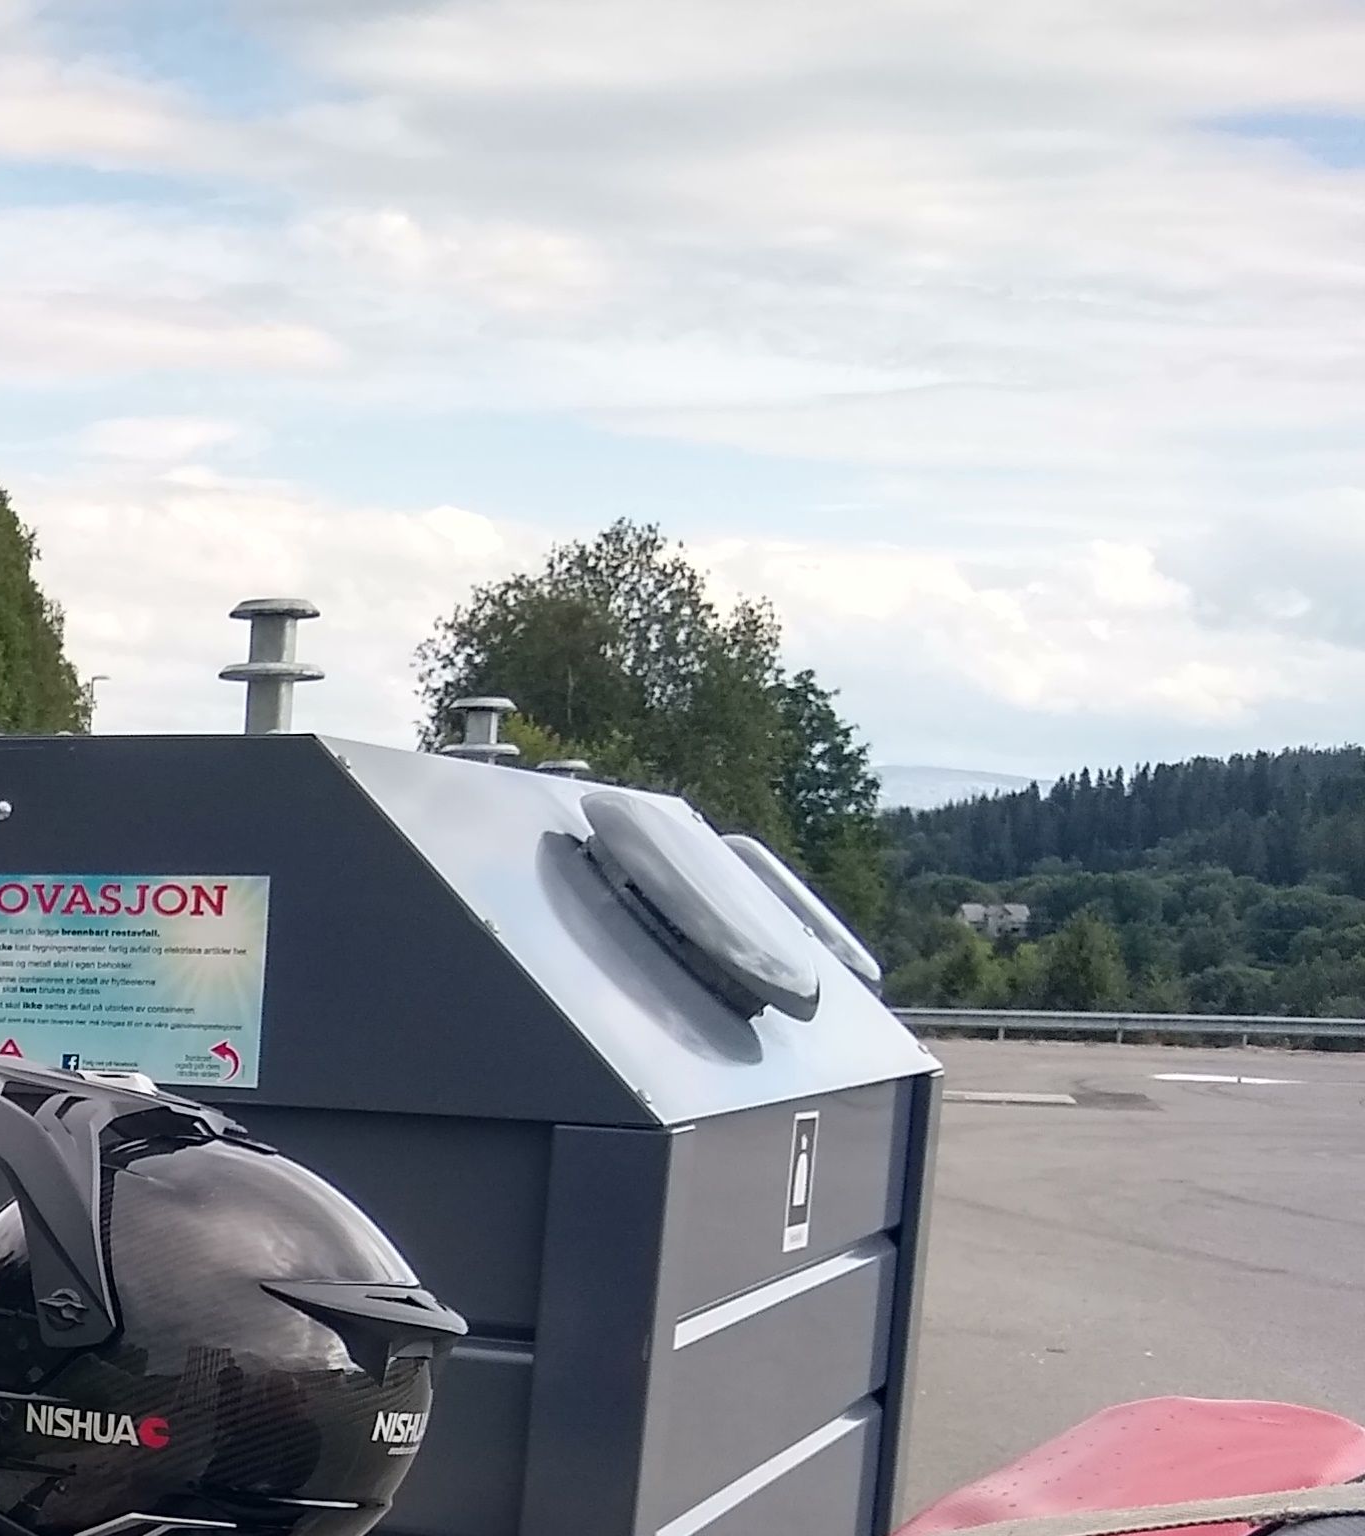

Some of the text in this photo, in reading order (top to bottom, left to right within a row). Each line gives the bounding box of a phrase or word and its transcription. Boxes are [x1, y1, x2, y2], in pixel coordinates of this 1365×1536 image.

[37, 928, 60, 938] legge
[61, 928, 109, 936] brennbart
[111, 929, 160, 938] restavfall.
[108, 945, 128, 955] farlig
[129, 946, 151, 954] avfall
[151, 947, 163, 955] og
[15, 961, 26, 969] og
[75, 962, 95, 970] egen
[19, 986, 38, 994] kun
[22, 1002, 43, 1010] ikke
[92, 1003, 103, 1011] på
[371, 1410, 429, 1443] NISHU
